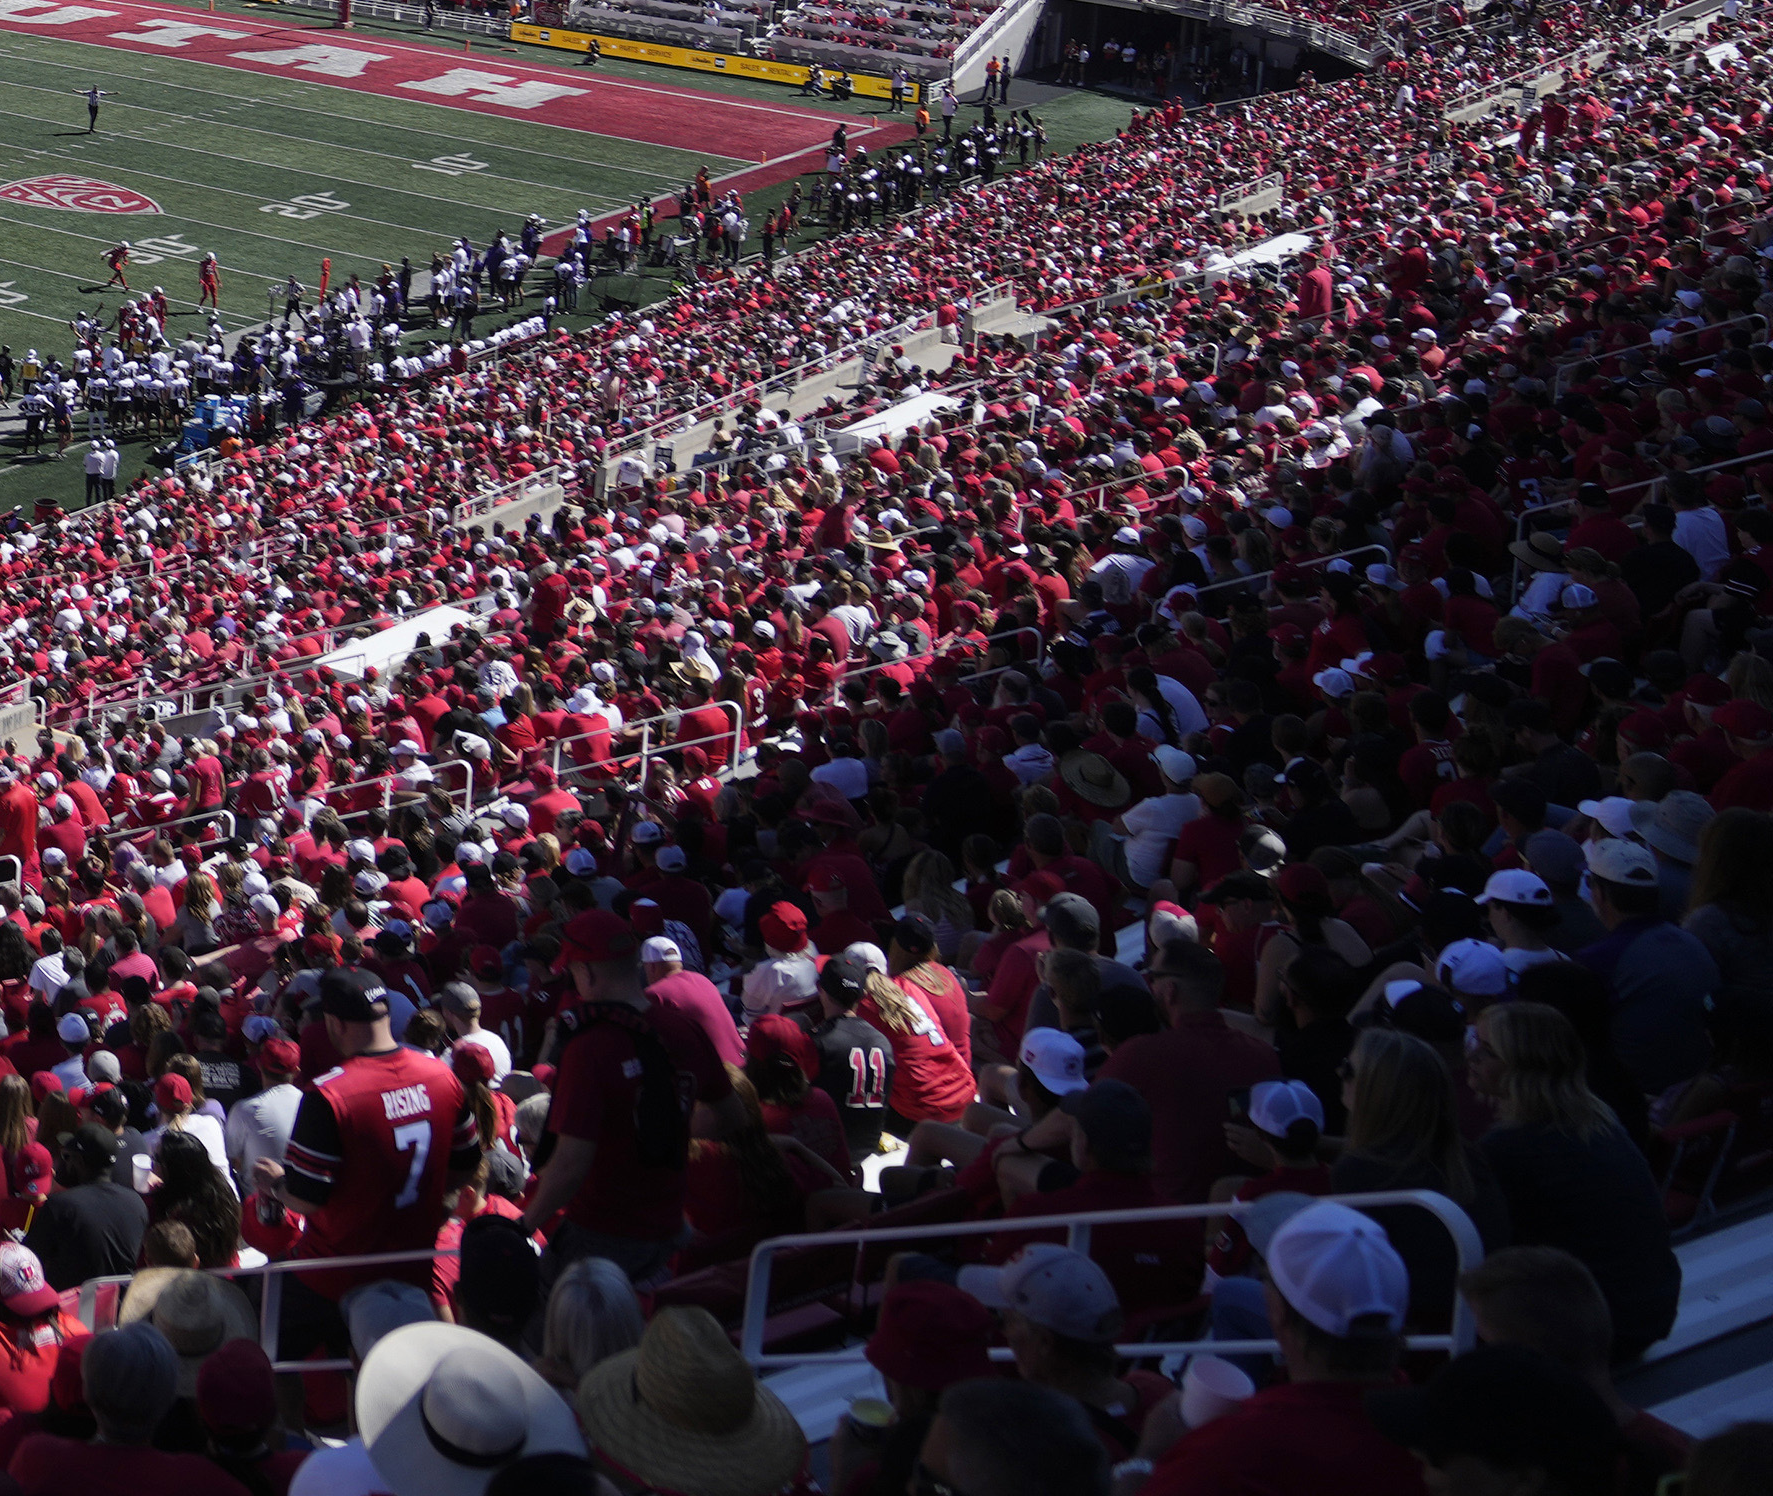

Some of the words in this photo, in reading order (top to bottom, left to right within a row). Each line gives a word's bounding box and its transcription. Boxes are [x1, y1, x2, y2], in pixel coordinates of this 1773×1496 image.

[412, 155, 490, 176] 10
[259, 194, 352, 220] 20
[847, 1046, 887, 1109] 11
[382, 1082, 431, 1121] RISING
[393, 1119, 432, 1209] 7
